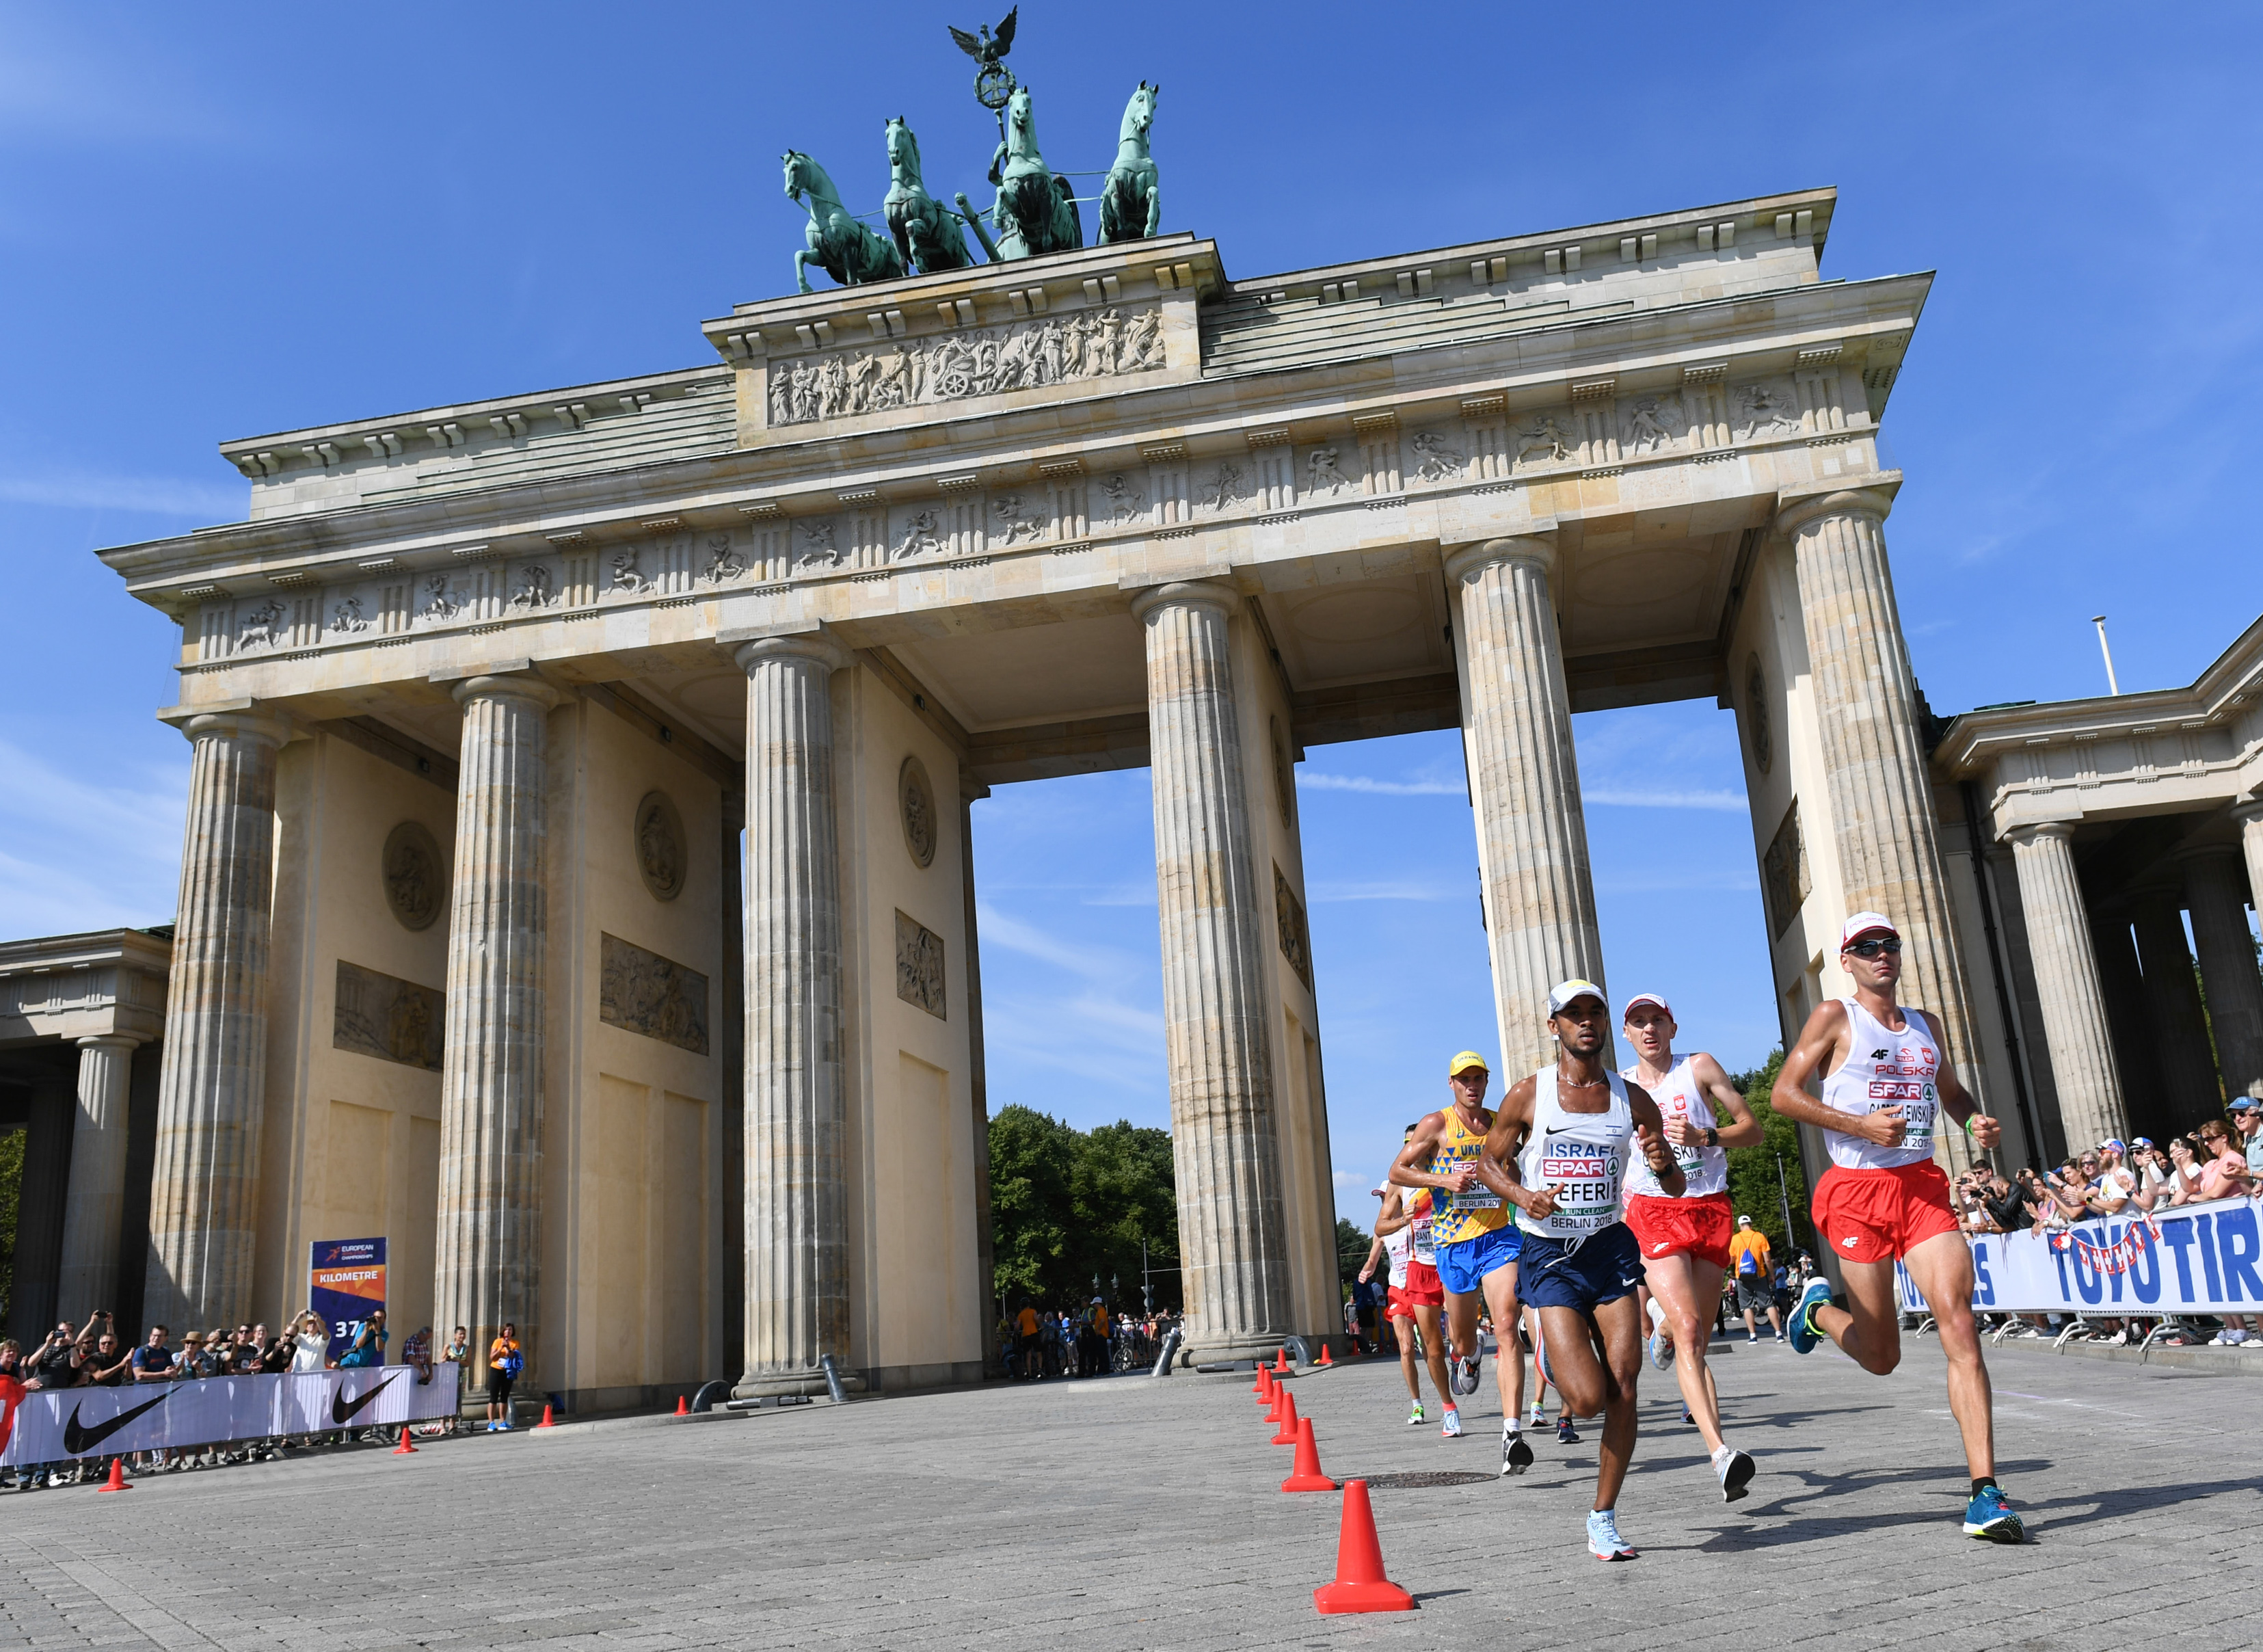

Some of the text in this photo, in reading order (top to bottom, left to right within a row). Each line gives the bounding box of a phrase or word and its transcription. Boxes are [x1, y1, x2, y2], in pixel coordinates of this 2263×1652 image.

[1871, 1049, 1889, 1060] 4F
[1875, 1064, 1935, 1080] POLSKA
[1870, 1084, 1920, 1098] SPAR
[1869, 1103, 1929, 1123] GLEWSKI
[1544, 1161, 1603, 1175] SPAR
[1551, 1214, 1613, 1229] BERLIN 2018
[1415, 1231, 1434, 1241] SANT
[1841, 1236, 1858, 1249] 4F
[341, 1244, 374, 1253] EUROPEAN
[1652, 1242, 1670, 1253] 4F
[2047, 1221, 2160, 1305] TOYO
[2160, 1205, 2263, 1303] TIR
[319, 1271, 378, 1283] KILOMETRE
[335, 1320, 360, 1338] 37
